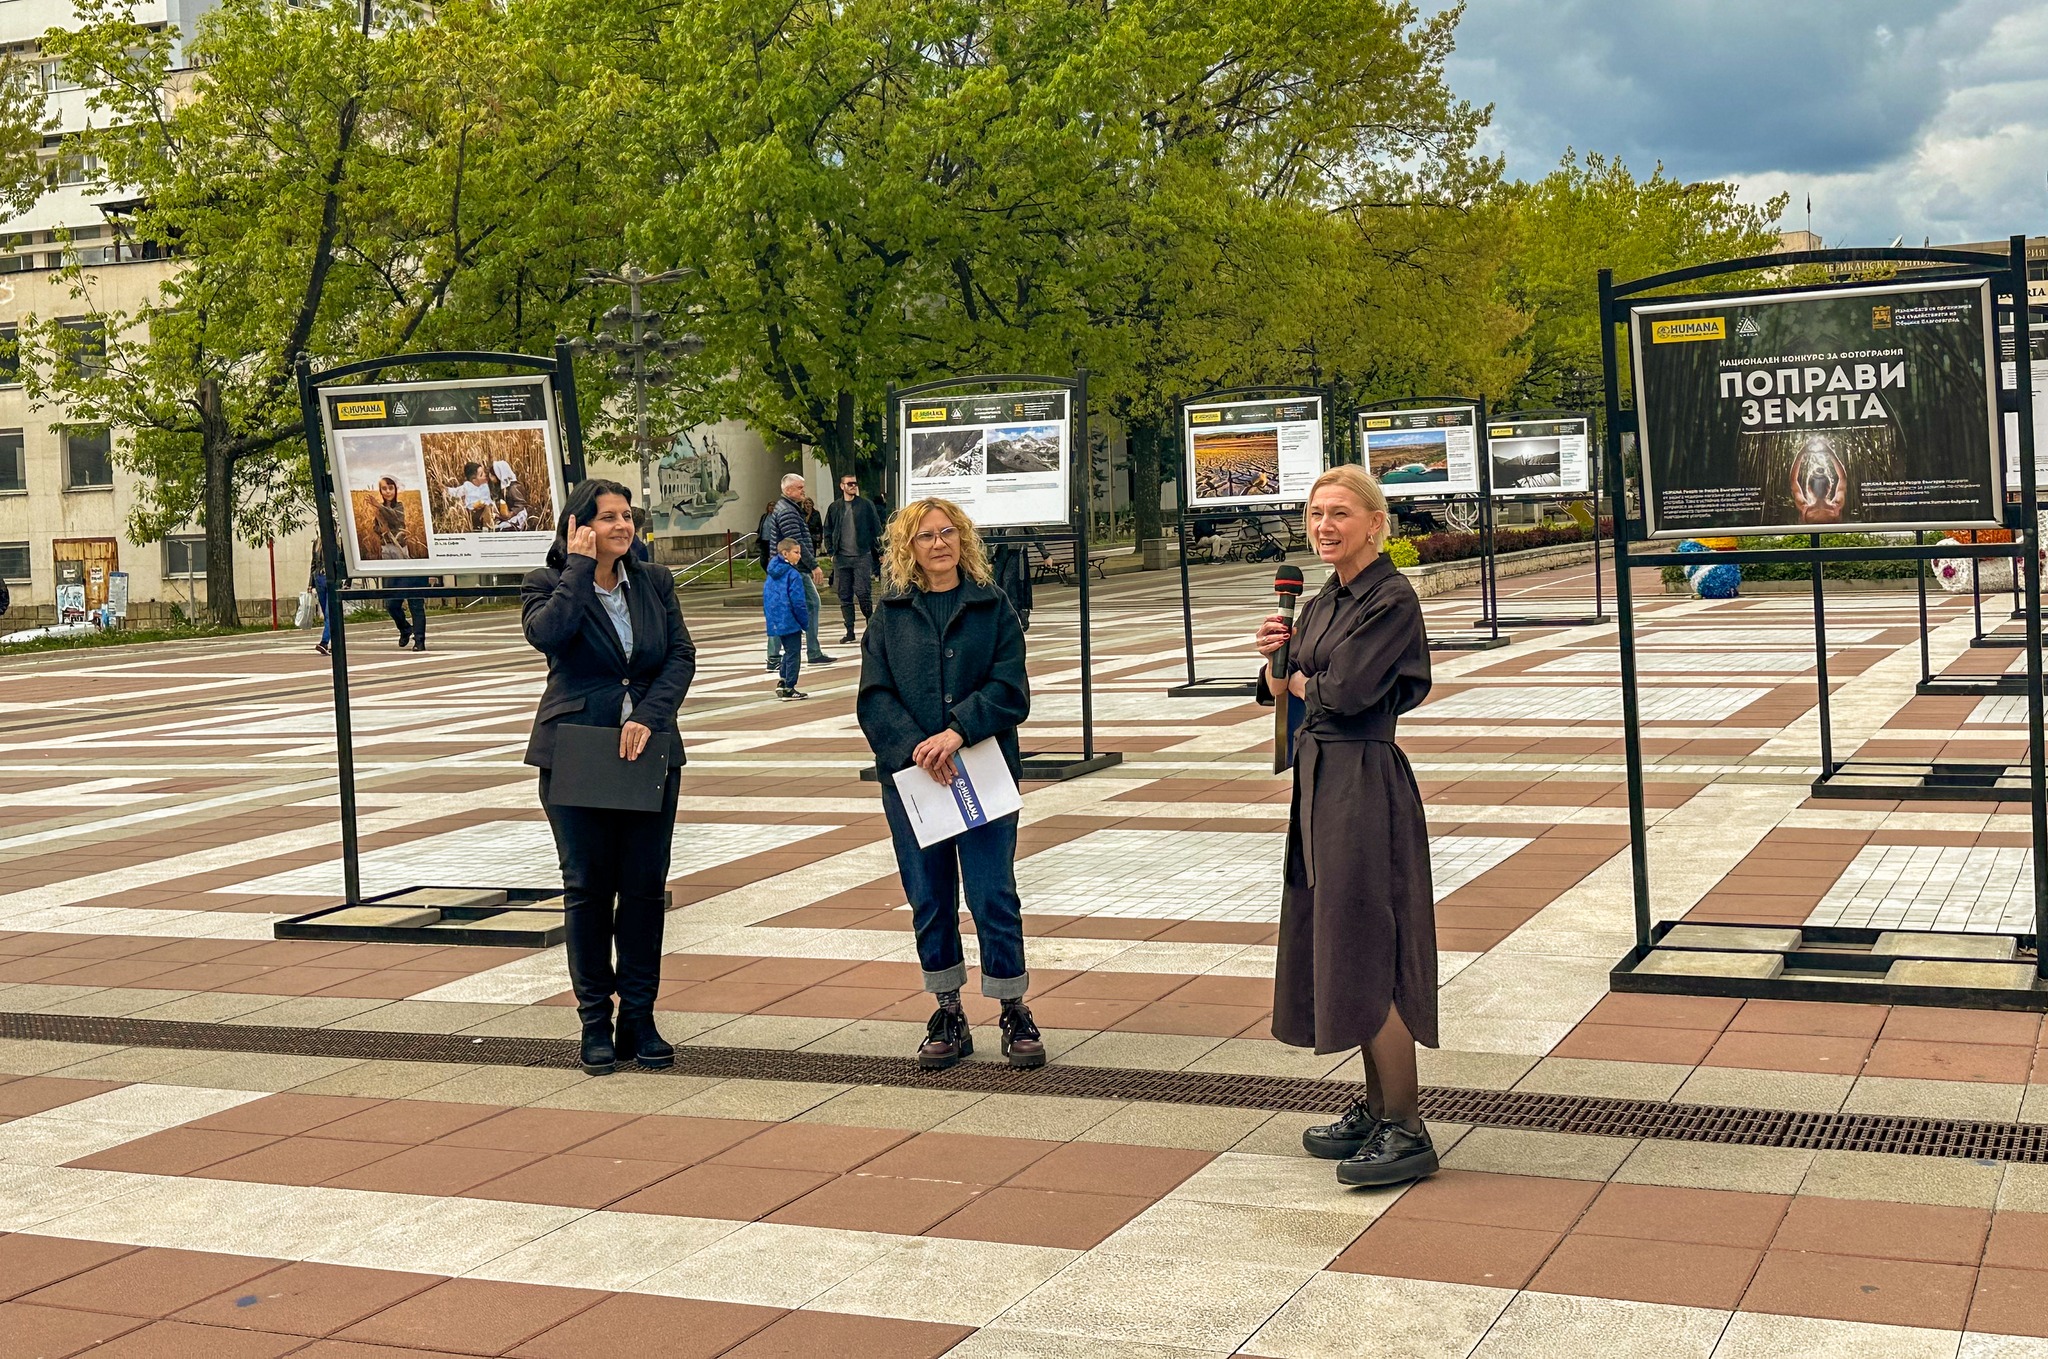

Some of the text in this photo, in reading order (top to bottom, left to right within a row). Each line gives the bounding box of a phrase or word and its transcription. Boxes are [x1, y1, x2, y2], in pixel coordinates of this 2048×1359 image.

[1670, 321, 1719, 334] HUMANA
[1719, 348, 1904, 367] НАЦИОНАЛЕН КОНКУРС ЗА ФОТОГРАФИЯ
[1719, 361, 1906, 399] ПОПРАВИ
[1741, 392, 1888, 426] ЗЕМЯТА
